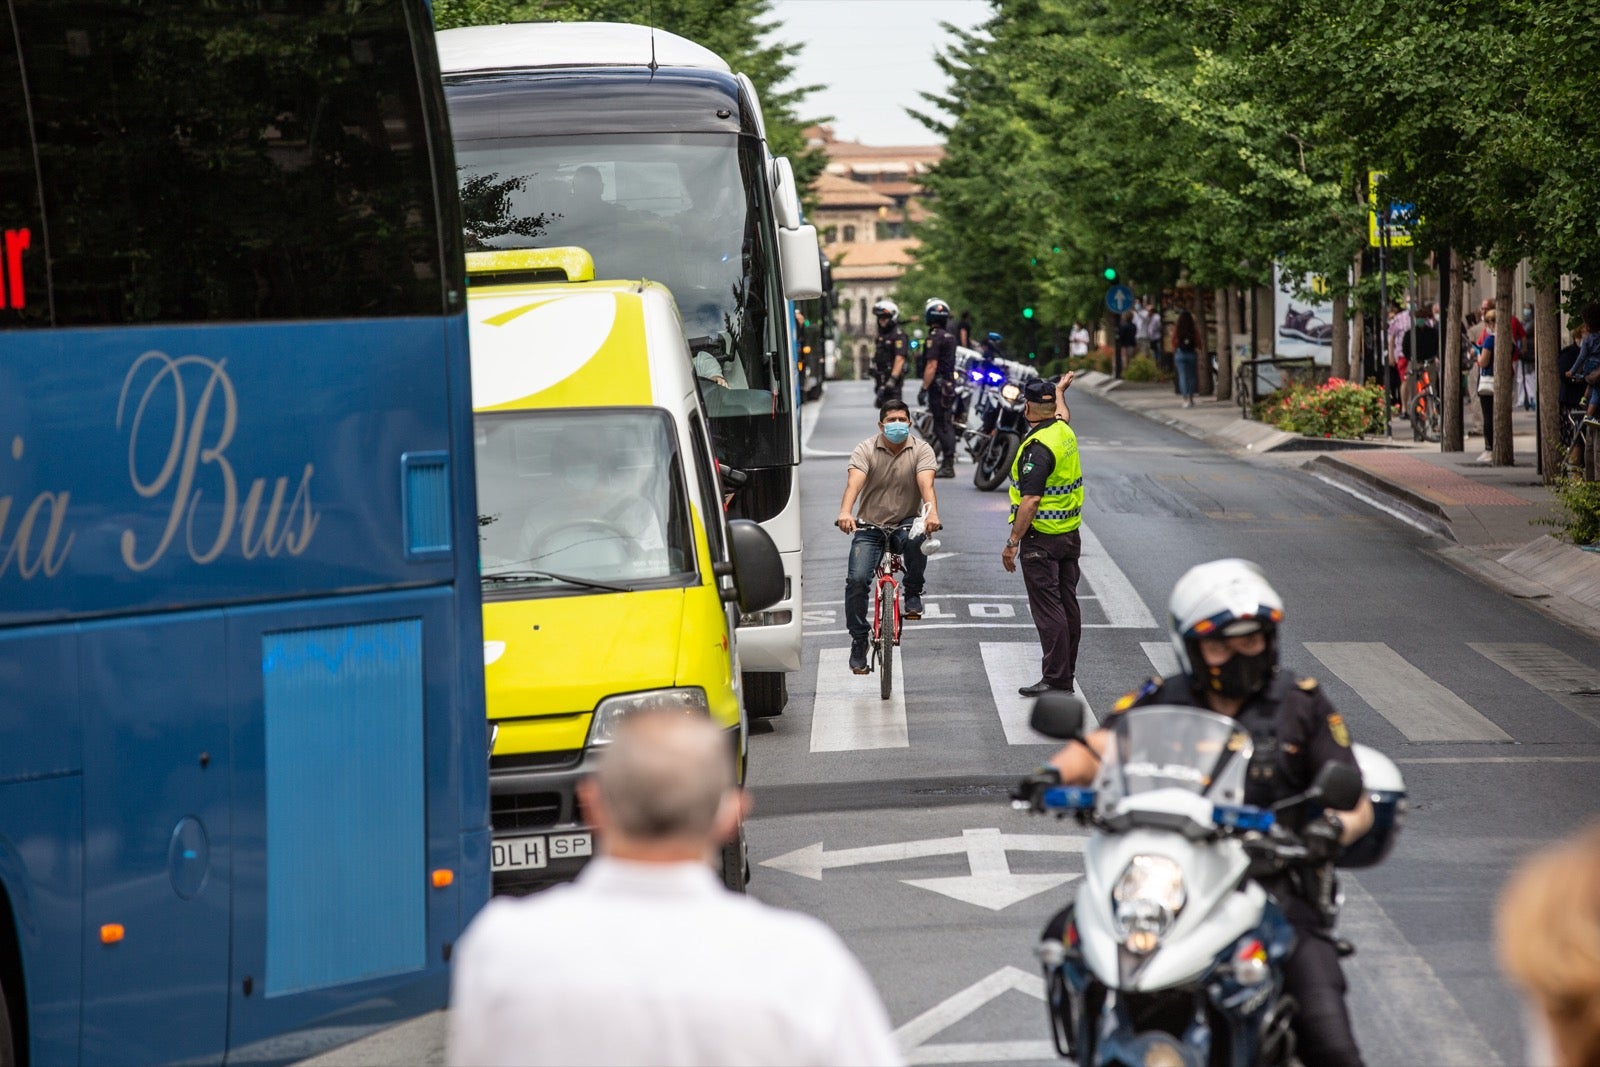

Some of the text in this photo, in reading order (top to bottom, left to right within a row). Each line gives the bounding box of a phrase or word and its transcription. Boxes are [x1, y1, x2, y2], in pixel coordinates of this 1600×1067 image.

[116, 350, 321, 572] Bus
[492, 842, 539, 868] DLH
[554, 838, 587, 855] SP
